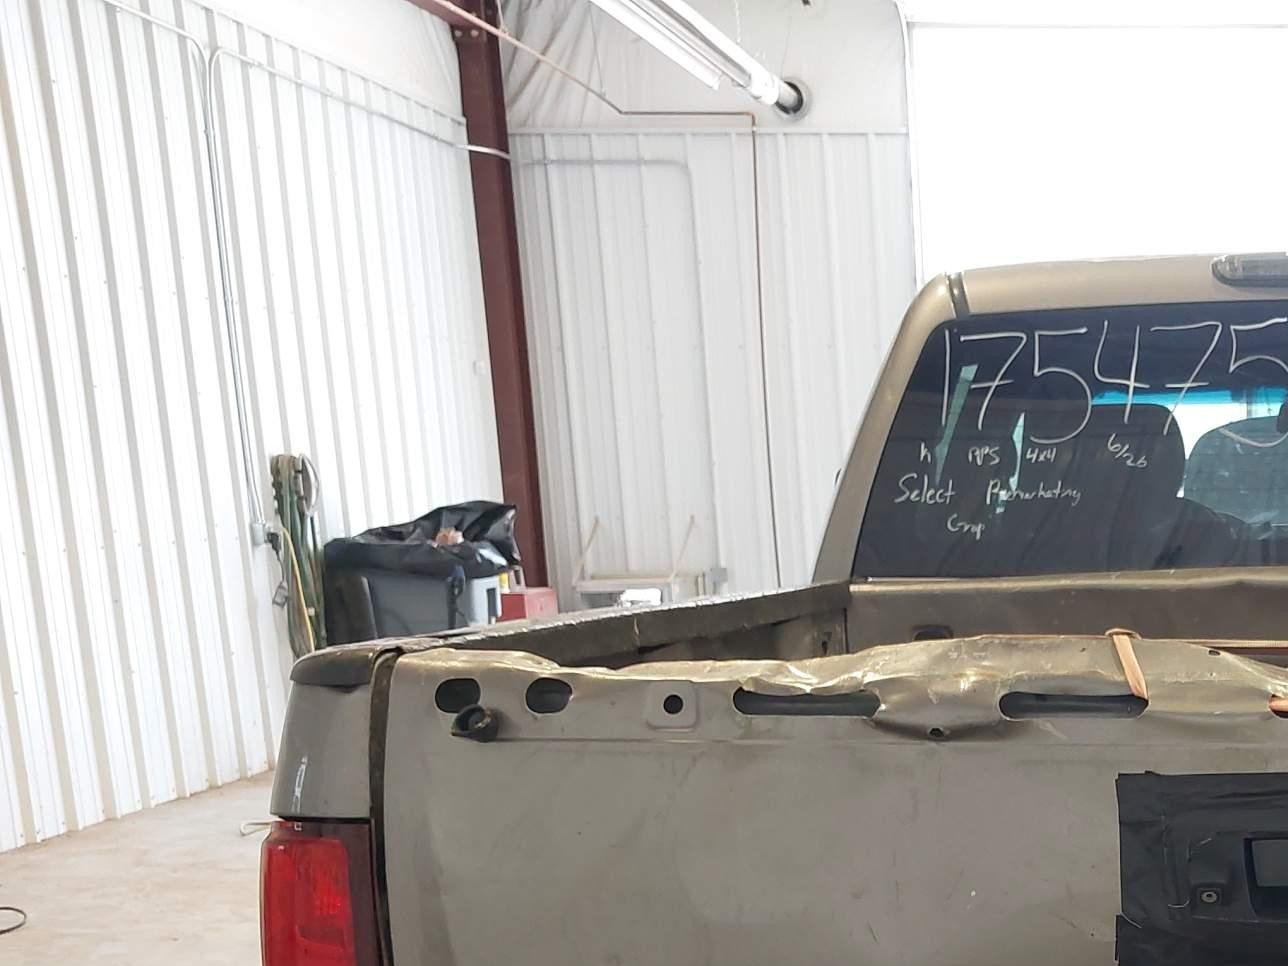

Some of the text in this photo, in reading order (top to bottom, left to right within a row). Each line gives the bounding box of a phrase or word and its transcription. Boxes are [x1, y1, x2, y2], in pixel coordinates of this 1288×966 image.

[1026, 447, 1056, 463] 4x4
[1107, 432, 1148, 468] 6/26
[894, 472, 956, 504] Select
